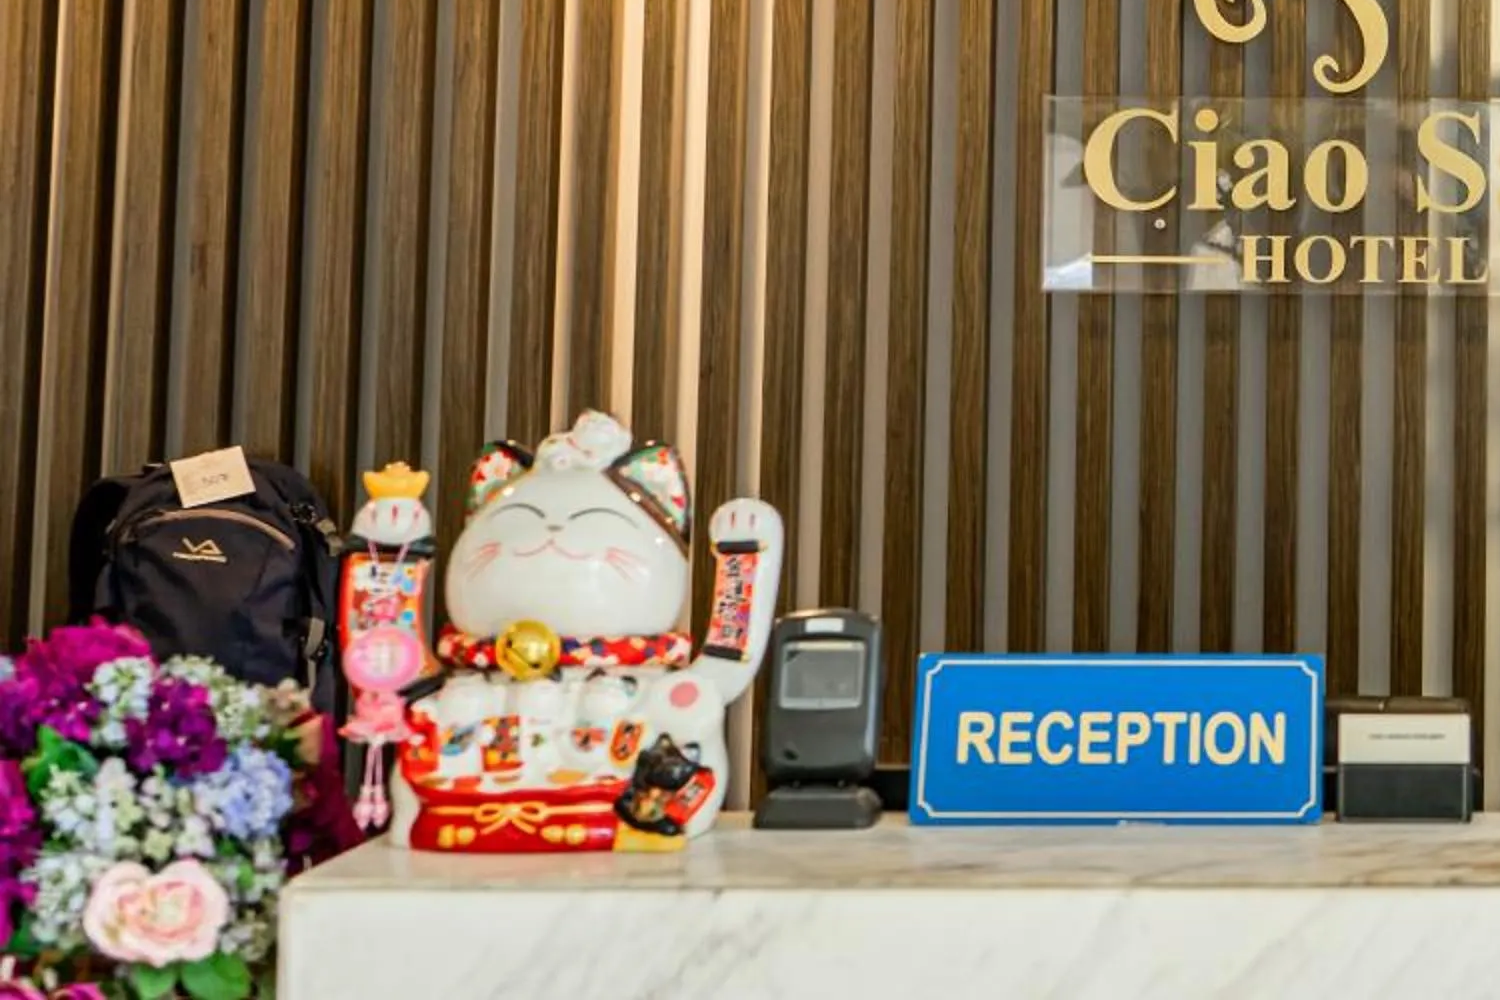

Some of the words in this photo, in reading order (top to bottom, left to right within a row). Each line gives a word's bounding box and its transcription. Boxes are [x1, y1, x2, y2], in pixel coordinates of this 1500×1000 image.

[1082, 107, 1369, 212] Ciao
[1241, 235, 1488, 285] HOTEL
[957, 711, 1286, 766] RECEPTION
